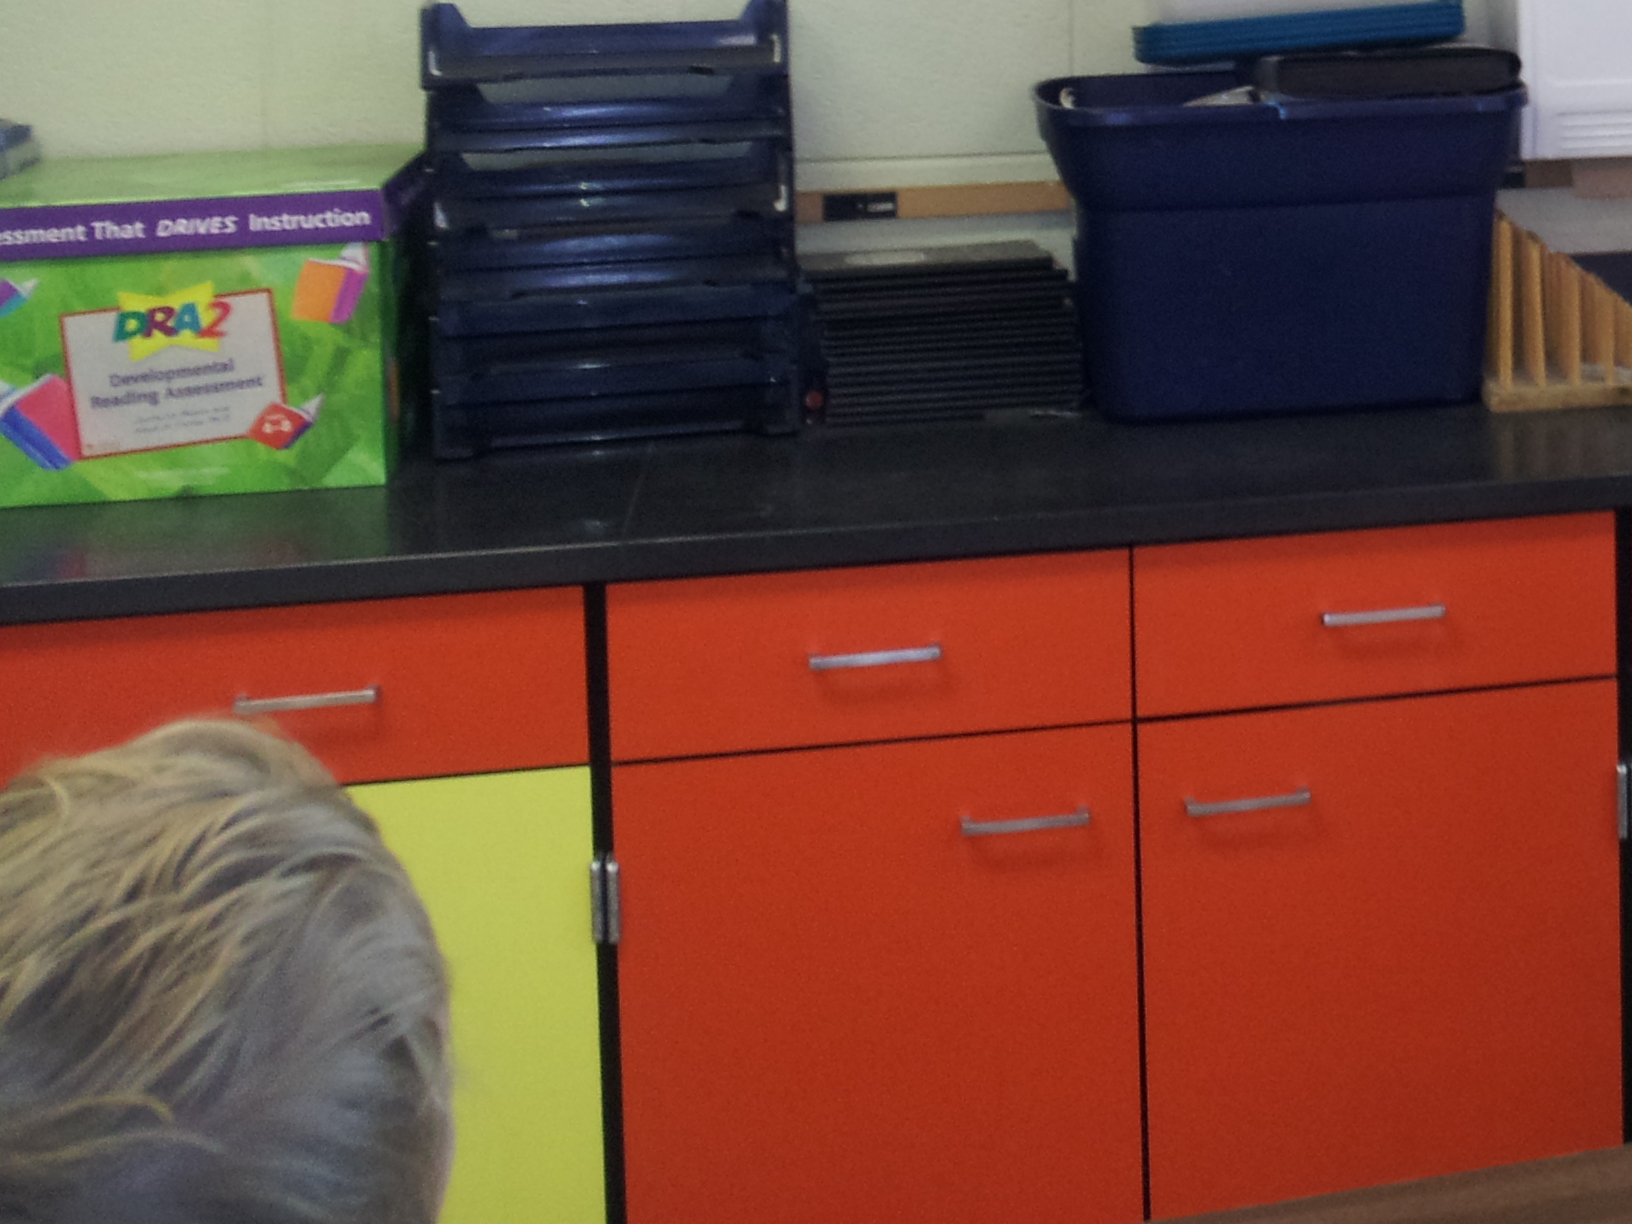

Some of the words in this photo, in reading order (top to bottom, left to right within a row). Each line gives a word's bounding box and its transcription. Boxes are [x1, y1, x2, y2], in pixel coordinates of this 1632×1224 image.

[0, 224, 88, 245] ssment
[92, 219, 146, 240] That
[155, 216, 239, 238] DRIVES
[248, 208, 373, 233] Instruction
[108, 357, 236, 388] Developmental
[90, 390, 161, 411] Reading
[164, 374, 265, 399] Assessment
